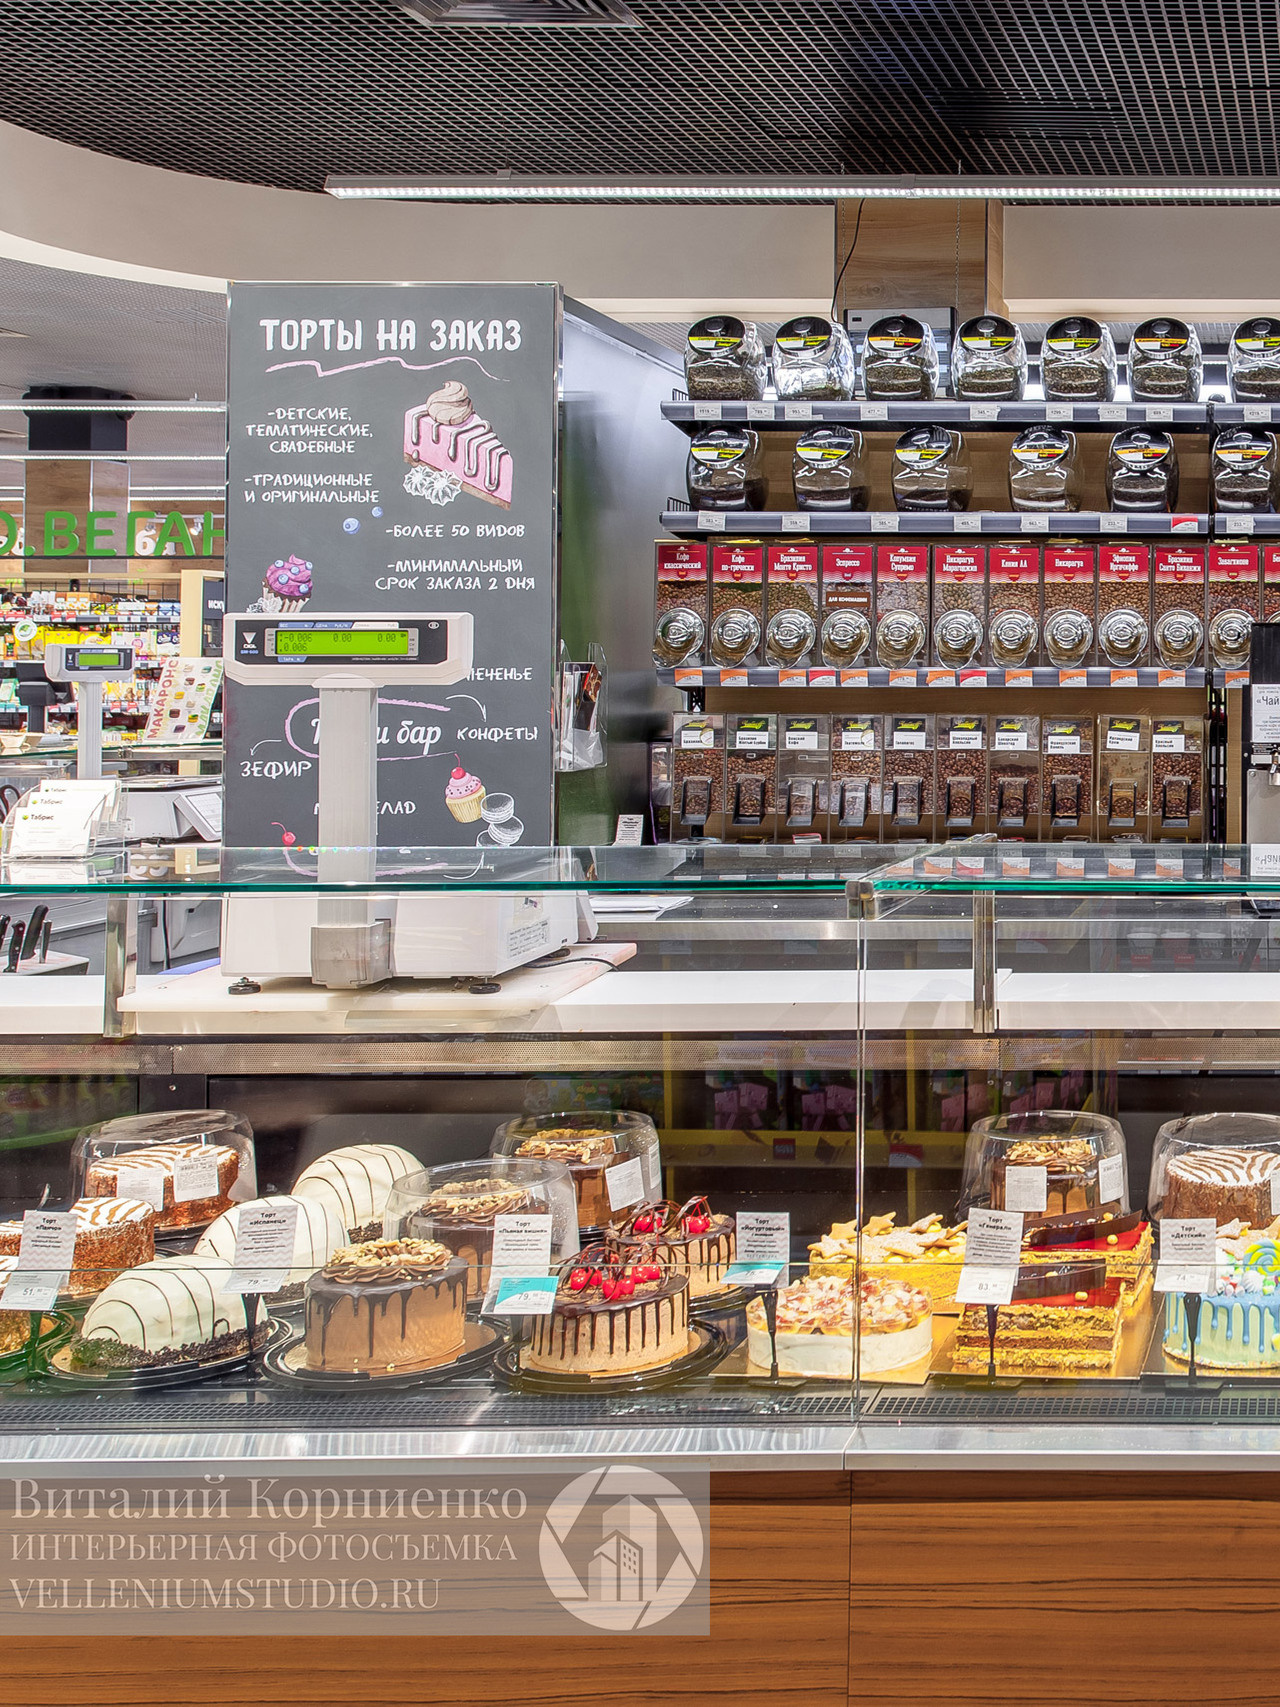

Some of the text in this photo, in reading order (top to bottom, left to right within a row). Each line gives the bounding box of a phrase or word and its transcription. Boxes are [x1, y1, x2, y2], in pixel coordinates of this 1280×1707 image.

[259, 319, 522, 351] ТОРТЫ НА ЗАКАЗ
[267, 407, 353, 421] -ДЕТСКИЕ,
[246, 423, 374, 438] ТЕМАТИЧЕСКИЕ,
[269, 440, 356, 454] СВАДЕБНЫЕ
[244, 473, 373, 488] -ТРАДИЦИОННЫЕ
[244, 490, 380, 504] И ОРИГИНАЛЬНЫЕ
[385, 524, 526, 538] -БОЛЕЕ 50 ВИДОВ
[676, 553, 690, 562] Кофе
[731, 555, 746, 564] Кофе
[835, 559, 860, 568] Эспрессо
[387, 558, 523, 573] -МИНИМАЛЬНЫЙ
[375, 576, 536, 591] СРОК ЗАКАЗА 2 ДНЯ
[397, 720, 442, 755] бар
[457, 726, 538, 742] КОНФЕТЫ
[239, 760, 312, 779] ЗЕФИР
[42, 1217, 57, 1225] Торт
[988, 1216, 1003, 1224] Торт
[1181, 1225, 1196, 1233] Торт
